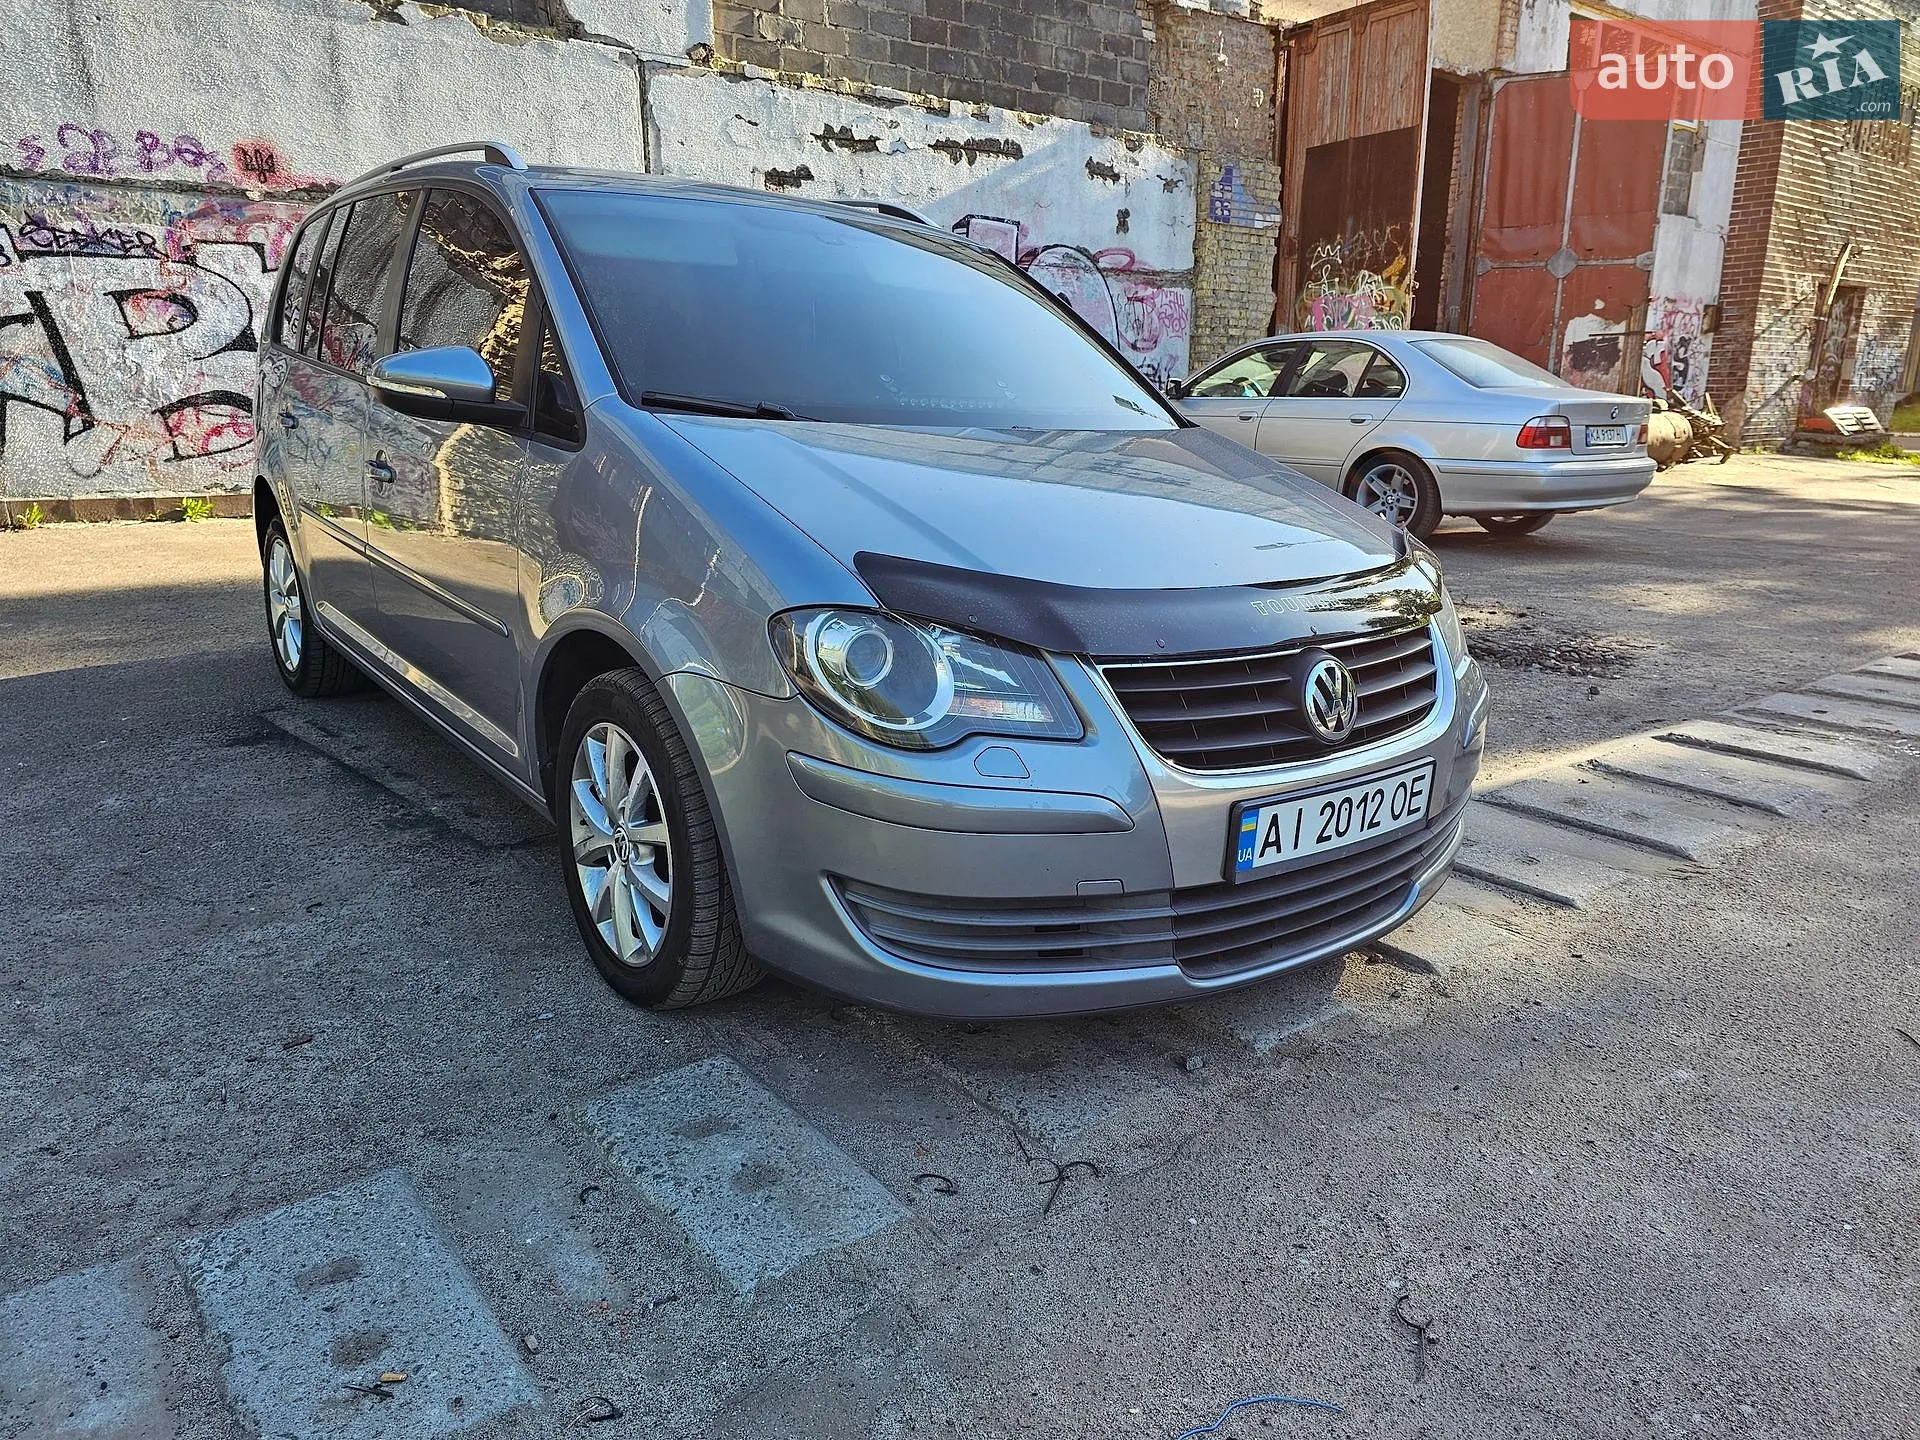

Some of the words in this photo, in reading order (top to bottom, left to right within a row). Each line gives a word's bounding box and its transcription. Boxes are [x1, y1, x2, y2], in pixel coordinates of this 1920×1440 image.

[1258, 808, 1303, 859] AI
[1315, 788, 1385, 844] 2012
[1390, 774, 1427, 821] OE
[1237, 848, 1253, 863] UA
